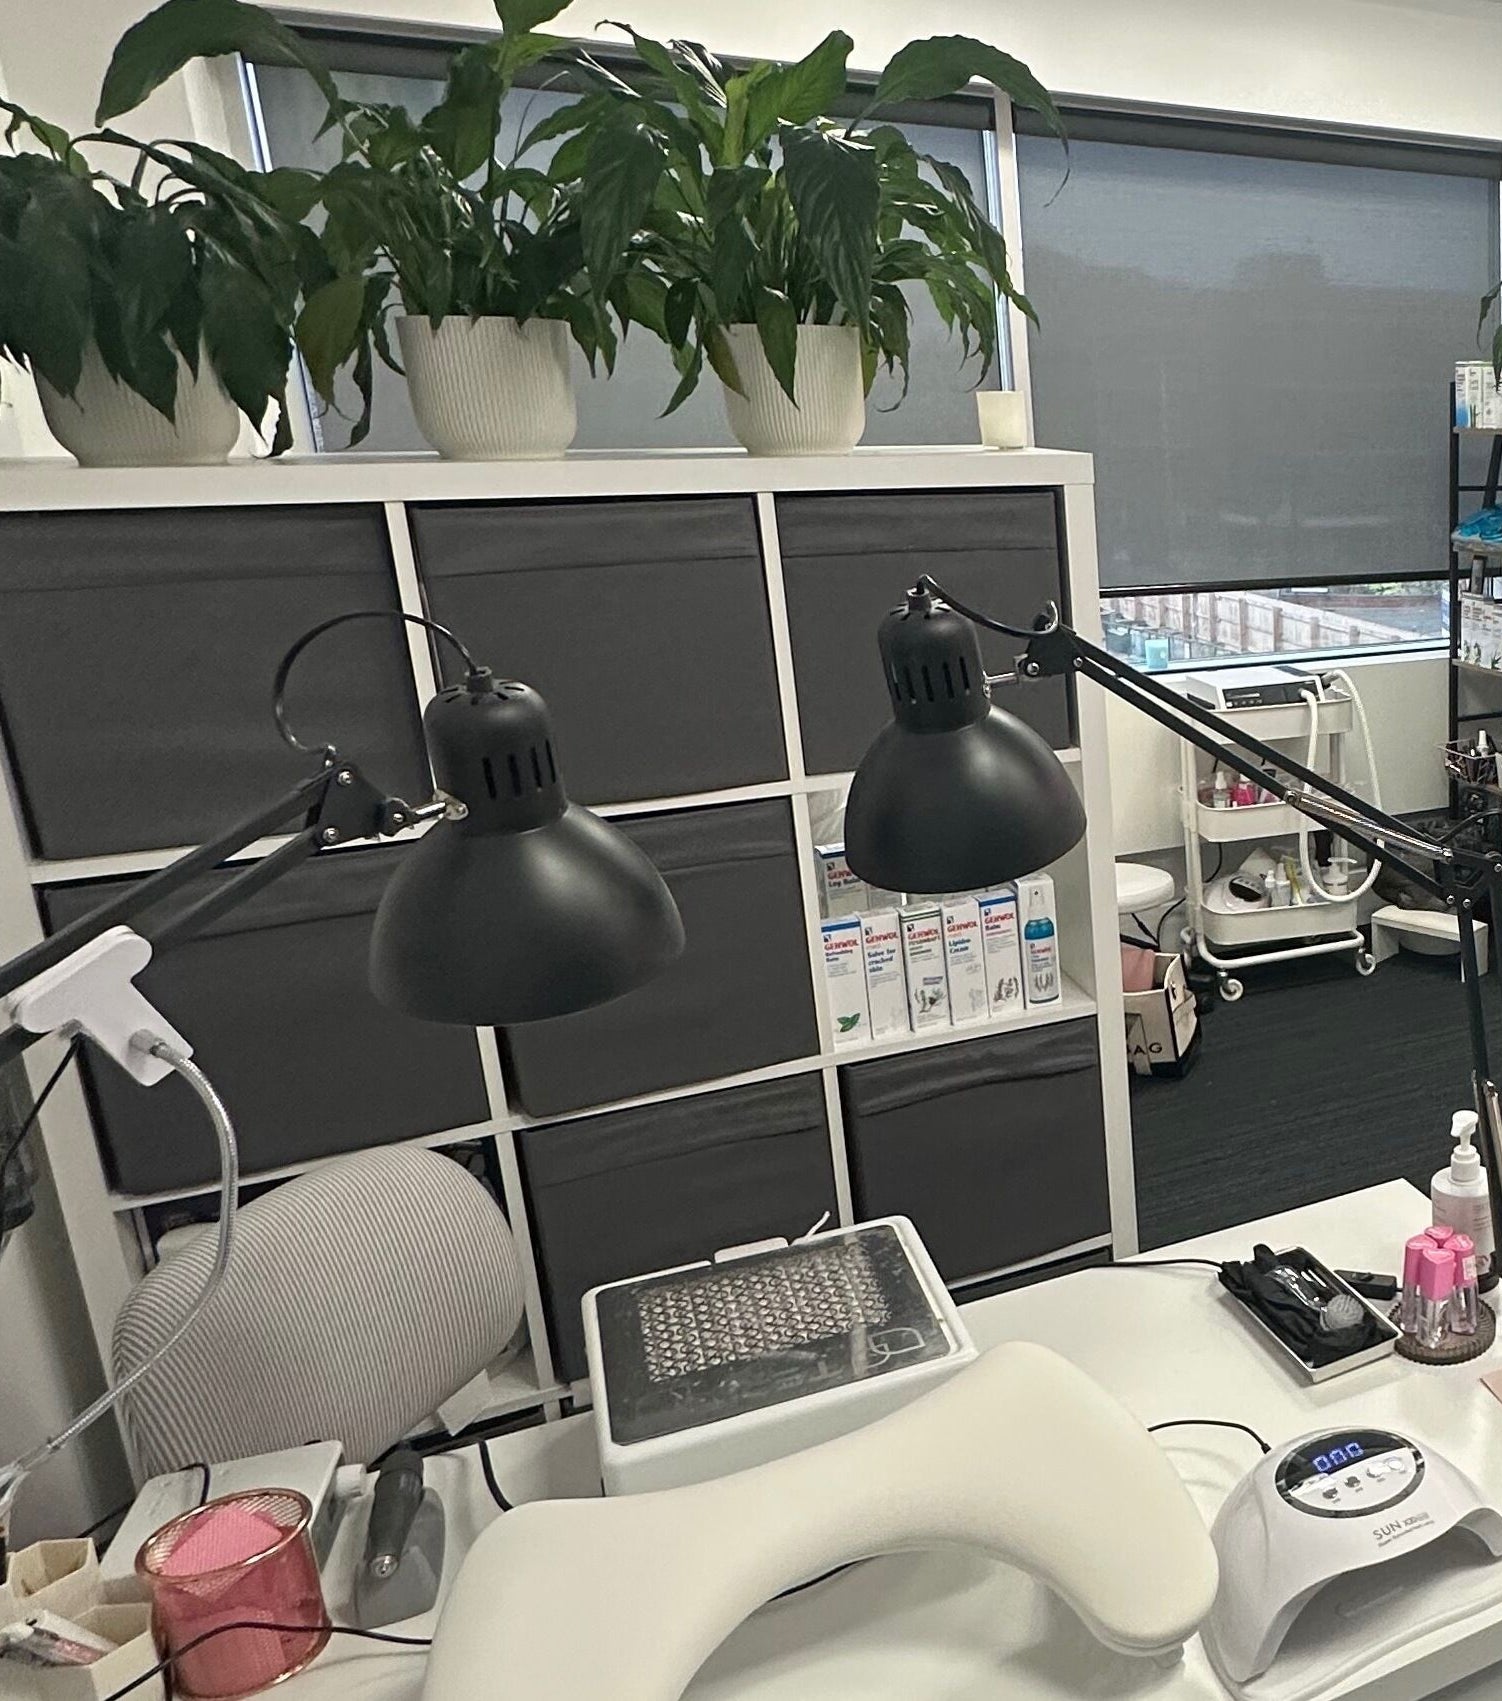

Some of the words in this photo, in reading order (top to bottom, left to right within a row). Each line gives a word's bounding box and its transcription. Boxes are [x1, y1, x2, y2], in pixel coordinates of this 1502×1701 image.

[984, 912, 1016, 925] GEHWOL
[946, 920, 978, 934] GEHWOL
[824, 938, 860, 952] GEHWOL
[864, 931, 899, 945] GEHWOL
[1372, 1519, 1402, 1541] SUN
